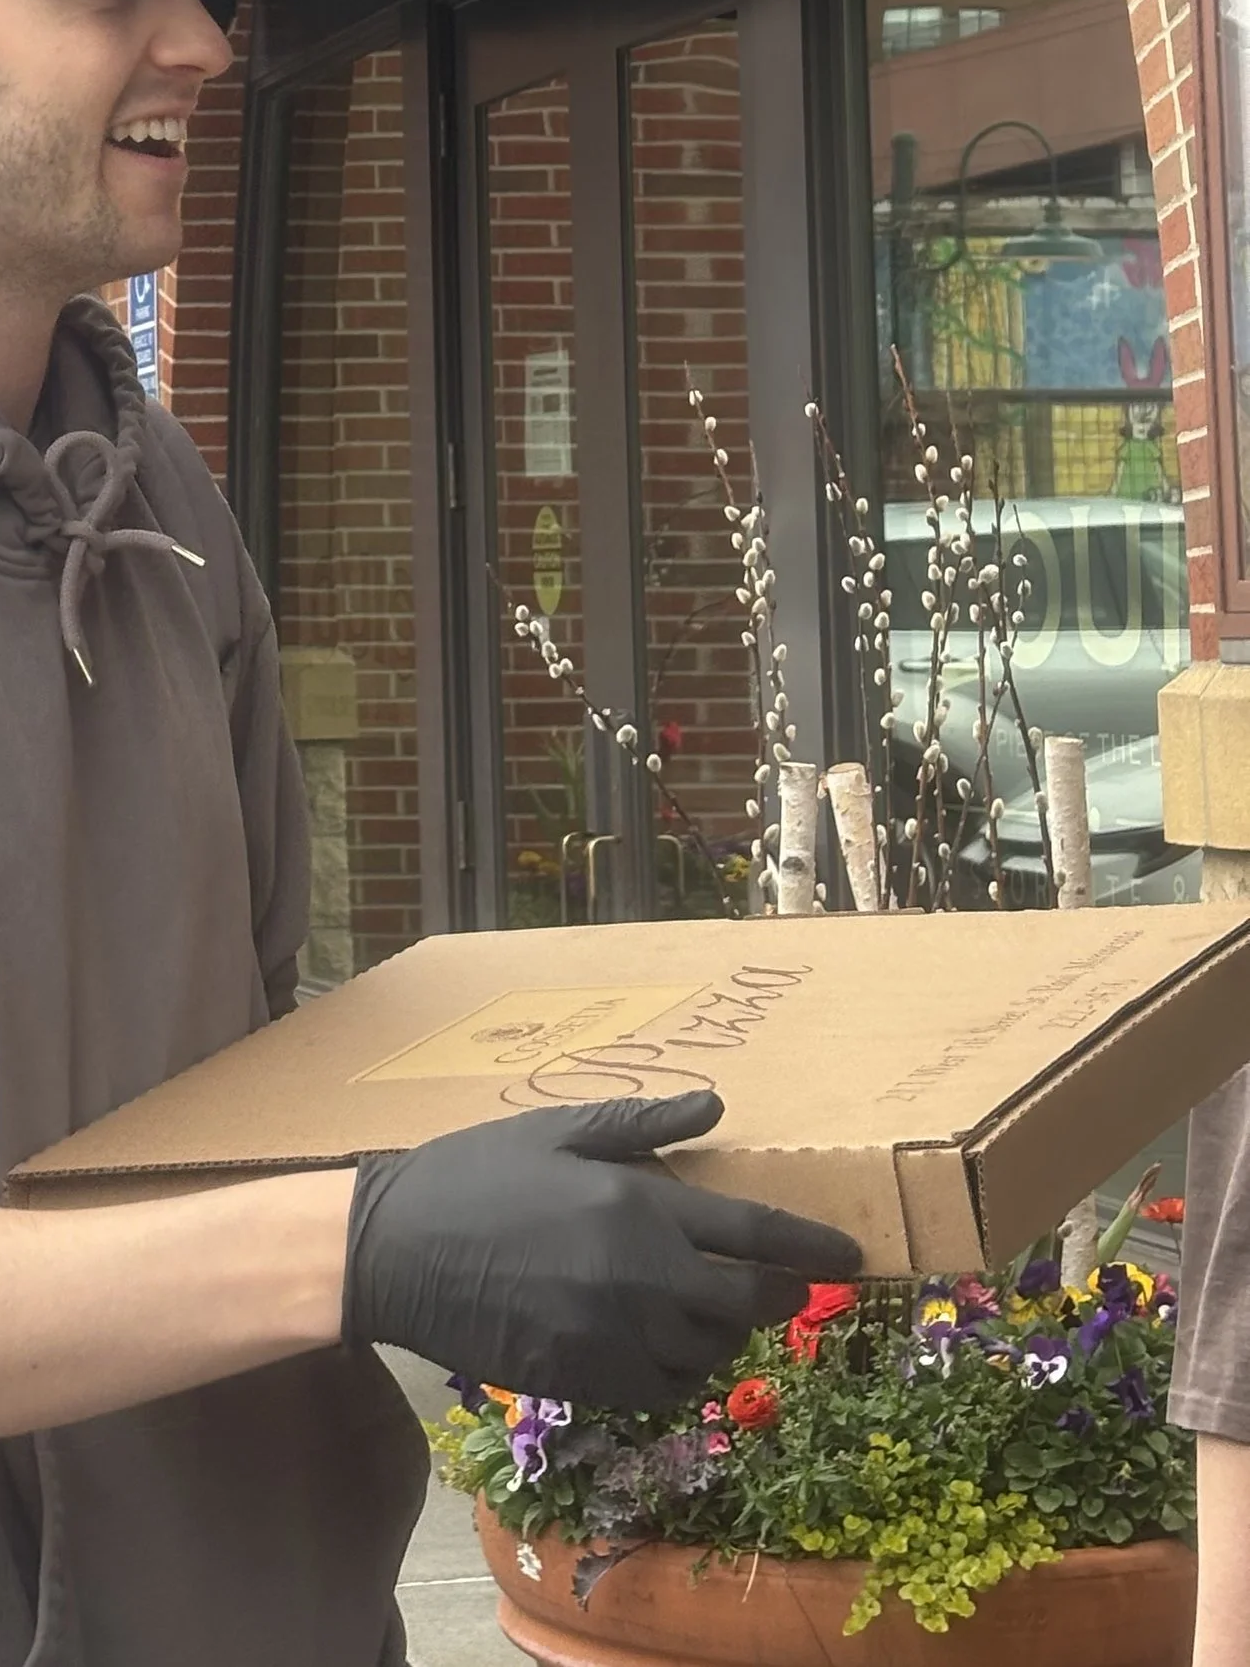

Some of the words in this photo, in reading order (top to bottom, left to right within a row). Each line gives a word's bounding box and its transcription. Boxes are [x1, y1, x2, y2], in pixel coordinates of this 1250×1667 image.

[1096, 733, 1141, 765] THE
[494, 997, 628, 1064] COSSETTA
[499, 964, 814, 1108] Pizza
